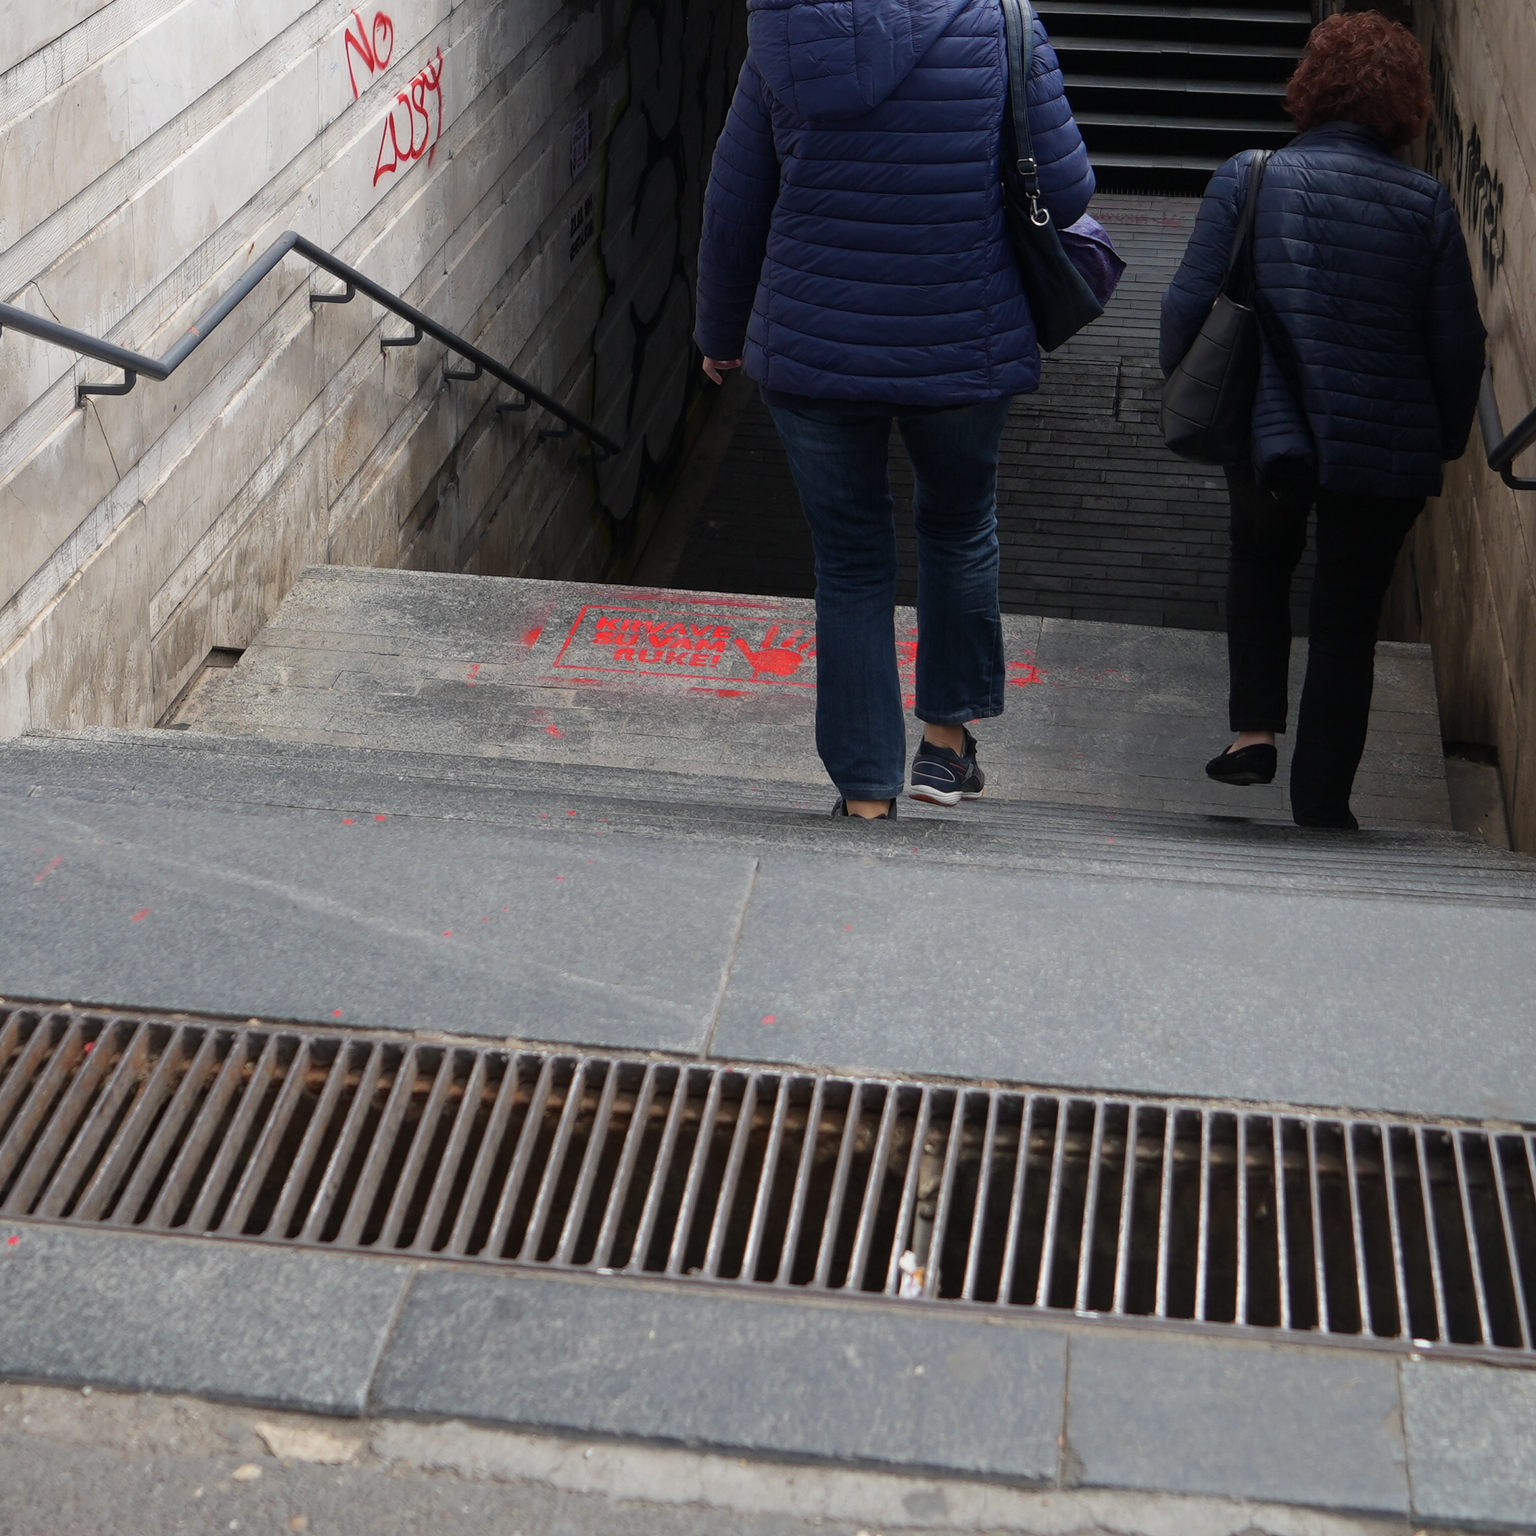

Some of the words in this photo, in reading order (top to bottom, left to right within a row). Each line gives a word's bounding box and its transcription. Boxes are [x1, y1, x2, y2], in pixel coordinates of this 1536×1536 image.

[345, 9, 394, 101] NO
[595, 616, 734, 640] KRVAVE
[592, 631, 640, 647] SU
[648, 634, 727, 653] VAM
[613, 648, 722, 668] RUKE!
